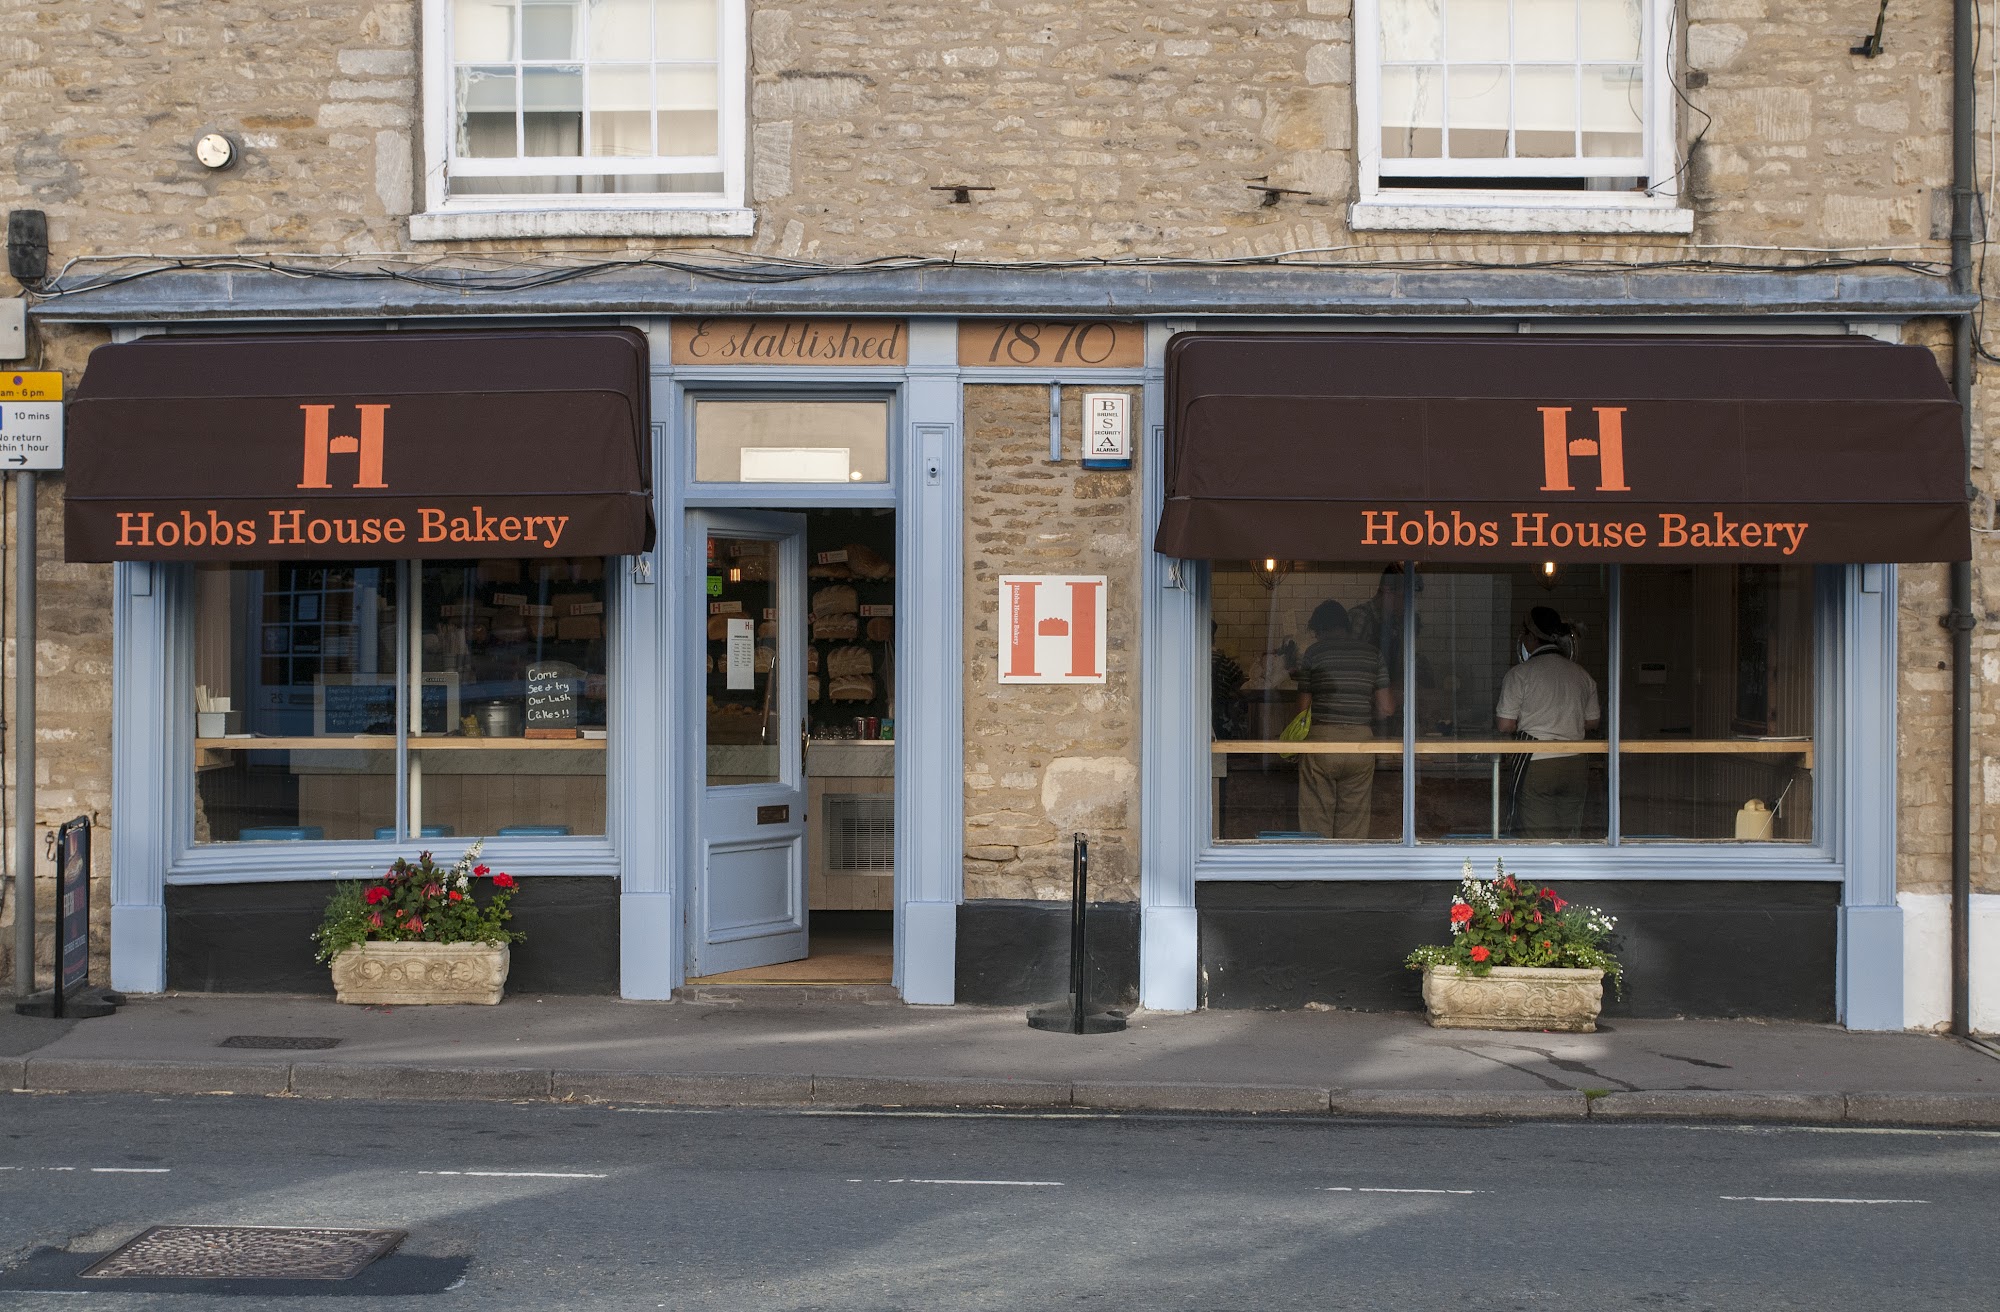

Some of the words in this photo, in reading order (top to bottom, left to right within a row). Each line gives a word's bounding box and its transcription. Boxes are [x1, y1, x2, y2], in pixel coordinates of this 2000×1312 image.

[689, 317, 900, 359] Established
[988, 322, 1116, 364] 1870
[22, 389, 28, 397] 6
[30, 390, 44, 399] pm
[1101, 400, 1115, 411] B
[15, 412, 26, 420] 10
[28, 412, 50, 420] mins
[1102, 418, 1113, 429] S
[12, 434, 42, 442] return
[1100, 436, 1115, 447] A
[0, 444, 17, 452] thin
[20, 444, 24, 452] 1
[27, 444, 49, 452] hour
[297, 404, 390, 488] H
[1537, 407, 1631, 491] H
[116, 509, 256, 547] Hobbs
[269, 509, 406, 545] House
[417, 505, 570, 549] Bakery
[1361, 509, 1498, 547] Hobbs
[1511, 512, 1647, 548] House
[1658, 511, 1809, 556] Bakery
[1012, 624, 1020, 646] Bakery
[528, 669, 558, 682] Come
[528, 684, 543, 694] See
[555, 681, 570, 692] try
[529, 697, 546, 706] Our
[548, 693, 571, 703] Lush
